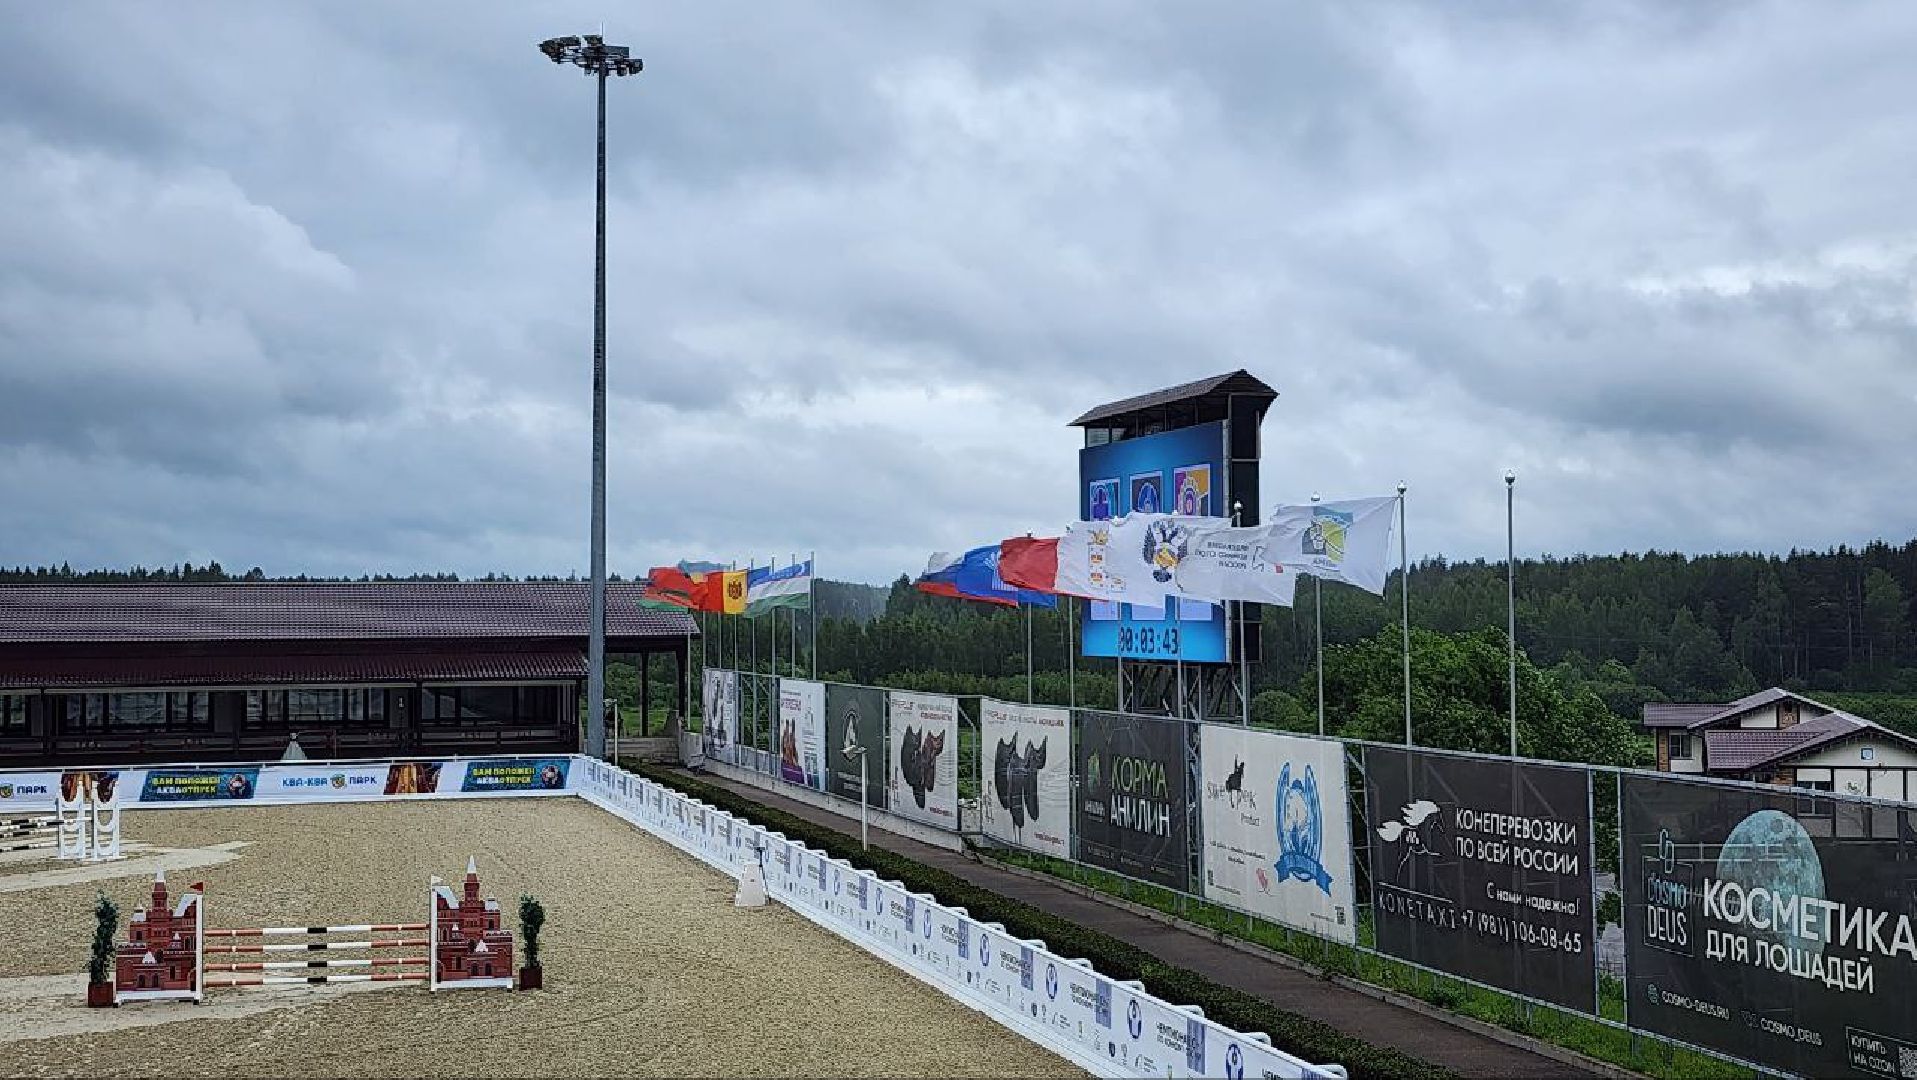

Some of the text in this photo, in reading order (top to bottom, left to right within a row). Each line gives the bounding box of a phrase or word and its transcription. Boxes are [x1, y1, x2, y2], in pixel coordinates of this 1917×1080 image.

[17, 785, 47, 794] ПАРК
[349, 775, 377, 785] ПАРК
[1111, 756, 1168, 799] КОРМА
[1110, 793, 1170, 837] АНИЛИН
[1456, 807, 1576, 845] КОНЕПЕРЕВОЗКИ
[1456, 837, 1578, 875] ПО ВСЕЙ РОССИИ
[1378, 891, 1455, 929] KONETAXI
[1486, 882, 1580, 916] С нами надежно!
[1648, 877, 1687, 909] COSMO
[1460, 910, 1581, 953] +7 (981) 106-08-65
[1648, 905, 1687, 945] DEUS
[1703, 878, 1917, 961] КОСМЕТИКА
[1706, 929, 1874, 994] ДЛЯ ЛОШАДЕЙ
[1851, 1035, 1886, 1055] КУПИТЬ
